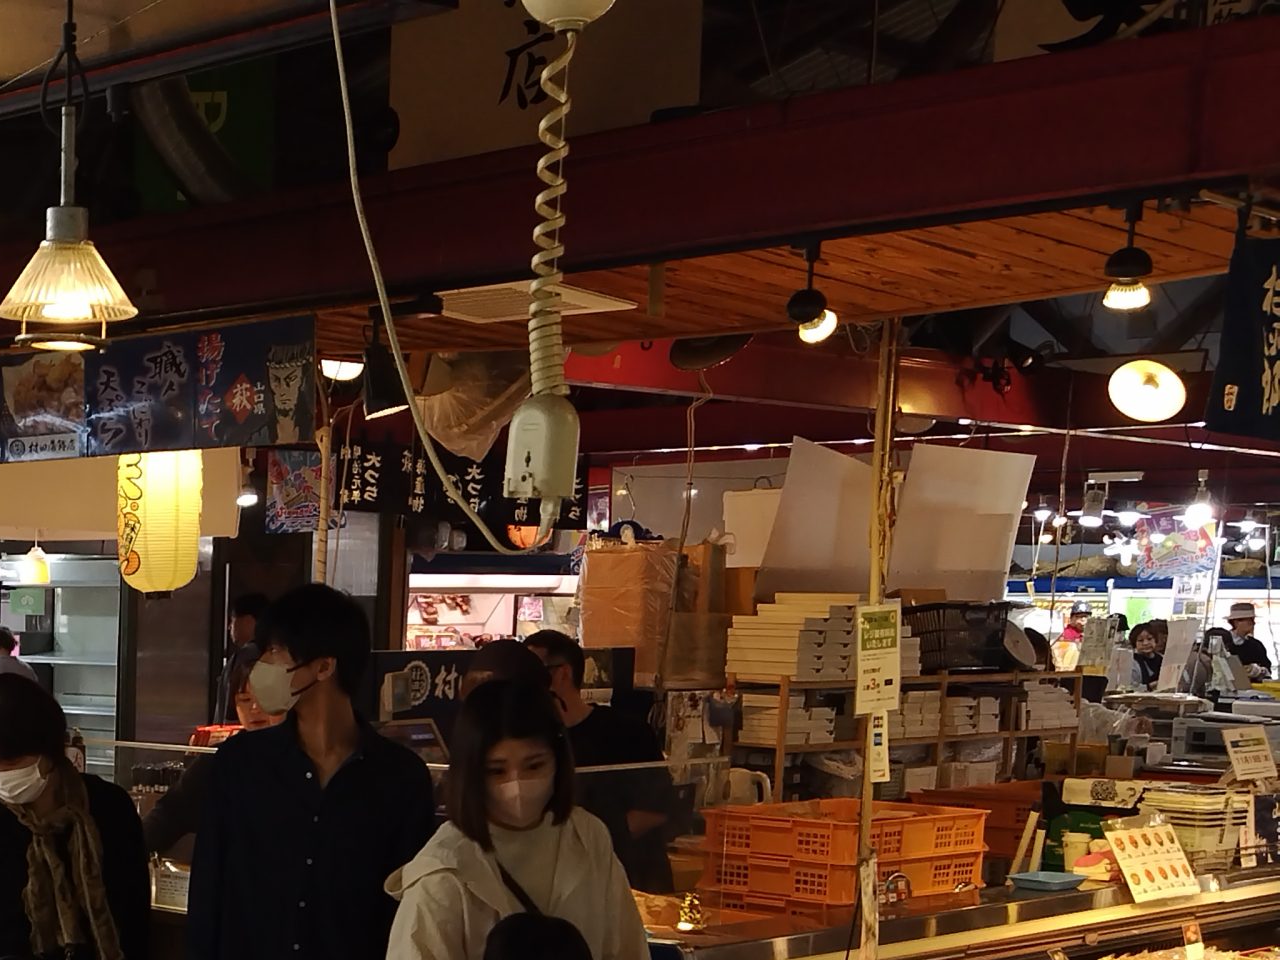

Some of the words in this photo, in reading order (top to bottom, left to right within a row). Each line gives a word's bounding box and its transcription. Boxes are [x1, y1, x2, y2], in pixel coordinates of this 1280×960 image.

[198, 335, 225, 441] 揚げたて
[231, 383, 252, 412] 萩
[253, 381, 267, 414] 山口県
